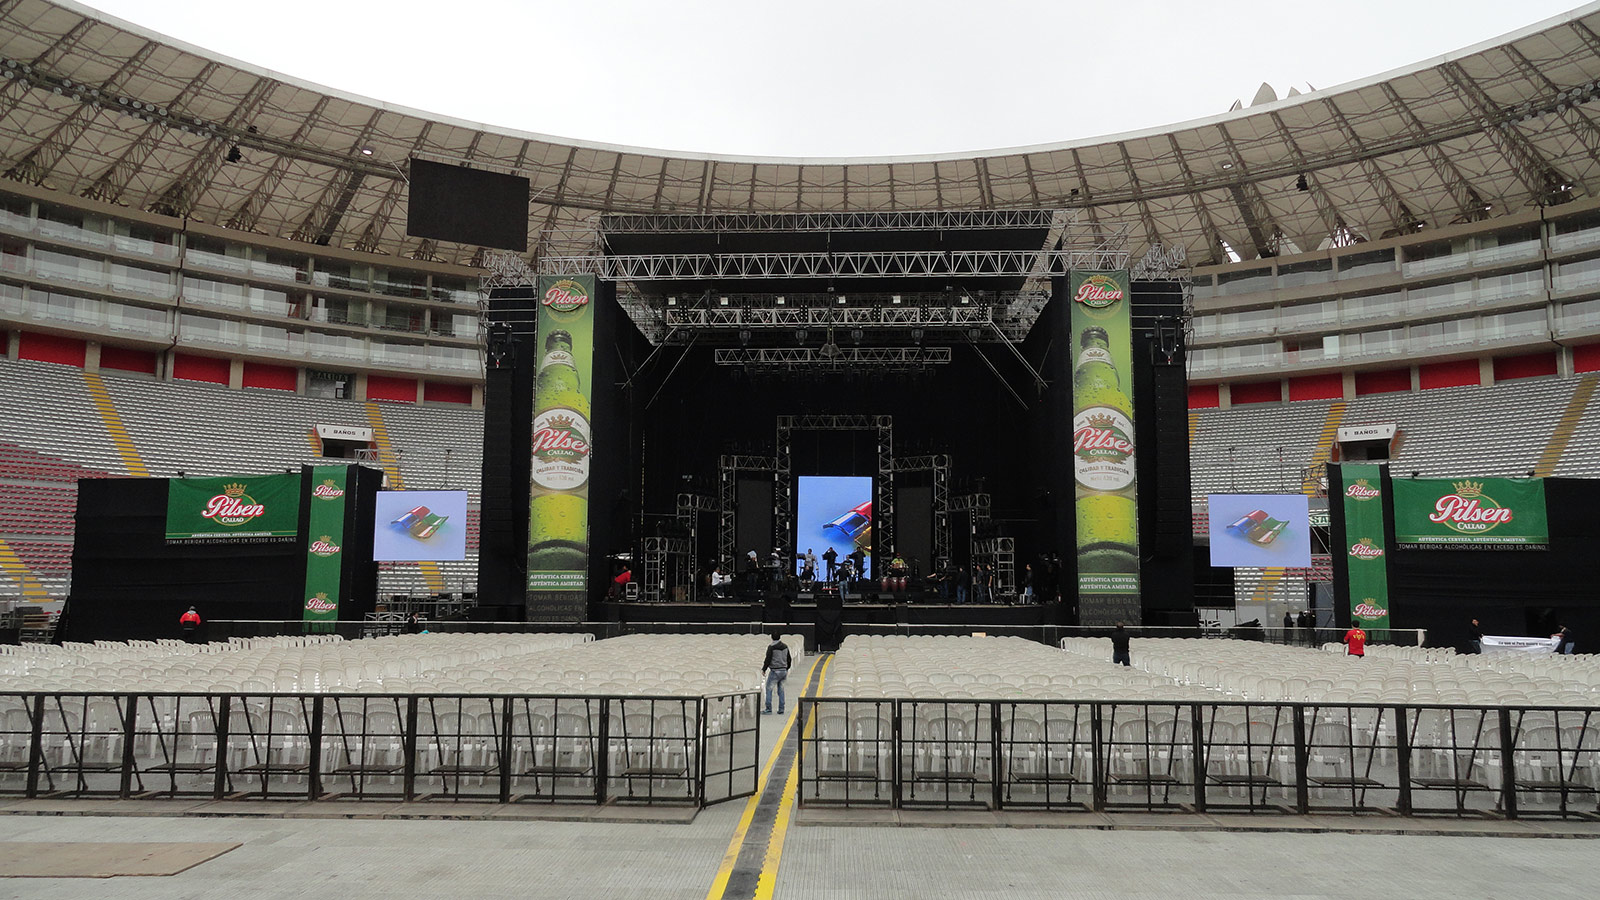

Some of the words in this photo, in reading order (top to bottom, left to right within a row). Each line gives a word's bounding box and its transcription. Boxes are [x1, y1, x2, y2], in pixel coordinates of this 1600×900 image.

[541, 287, 589, 306] Pilsen
[1074, 283, 1123, 302] Pilsen
[313, 484, 344, 496] Pilsen
[1345, 484, 1380, 497] Pilsen
[201, 494, 265, 519] Pilsen
[1428, 494, 1513, 524] Pilsen
[1457, 521, 1486, 530] CALLAO
[309, 541, 340, 552] Pilsen
[1349, 544, 1384, 556] Pilsen
[305, 598, 336, 609] Pilsen
[1353, 603, 1388, 616] Pilsen
